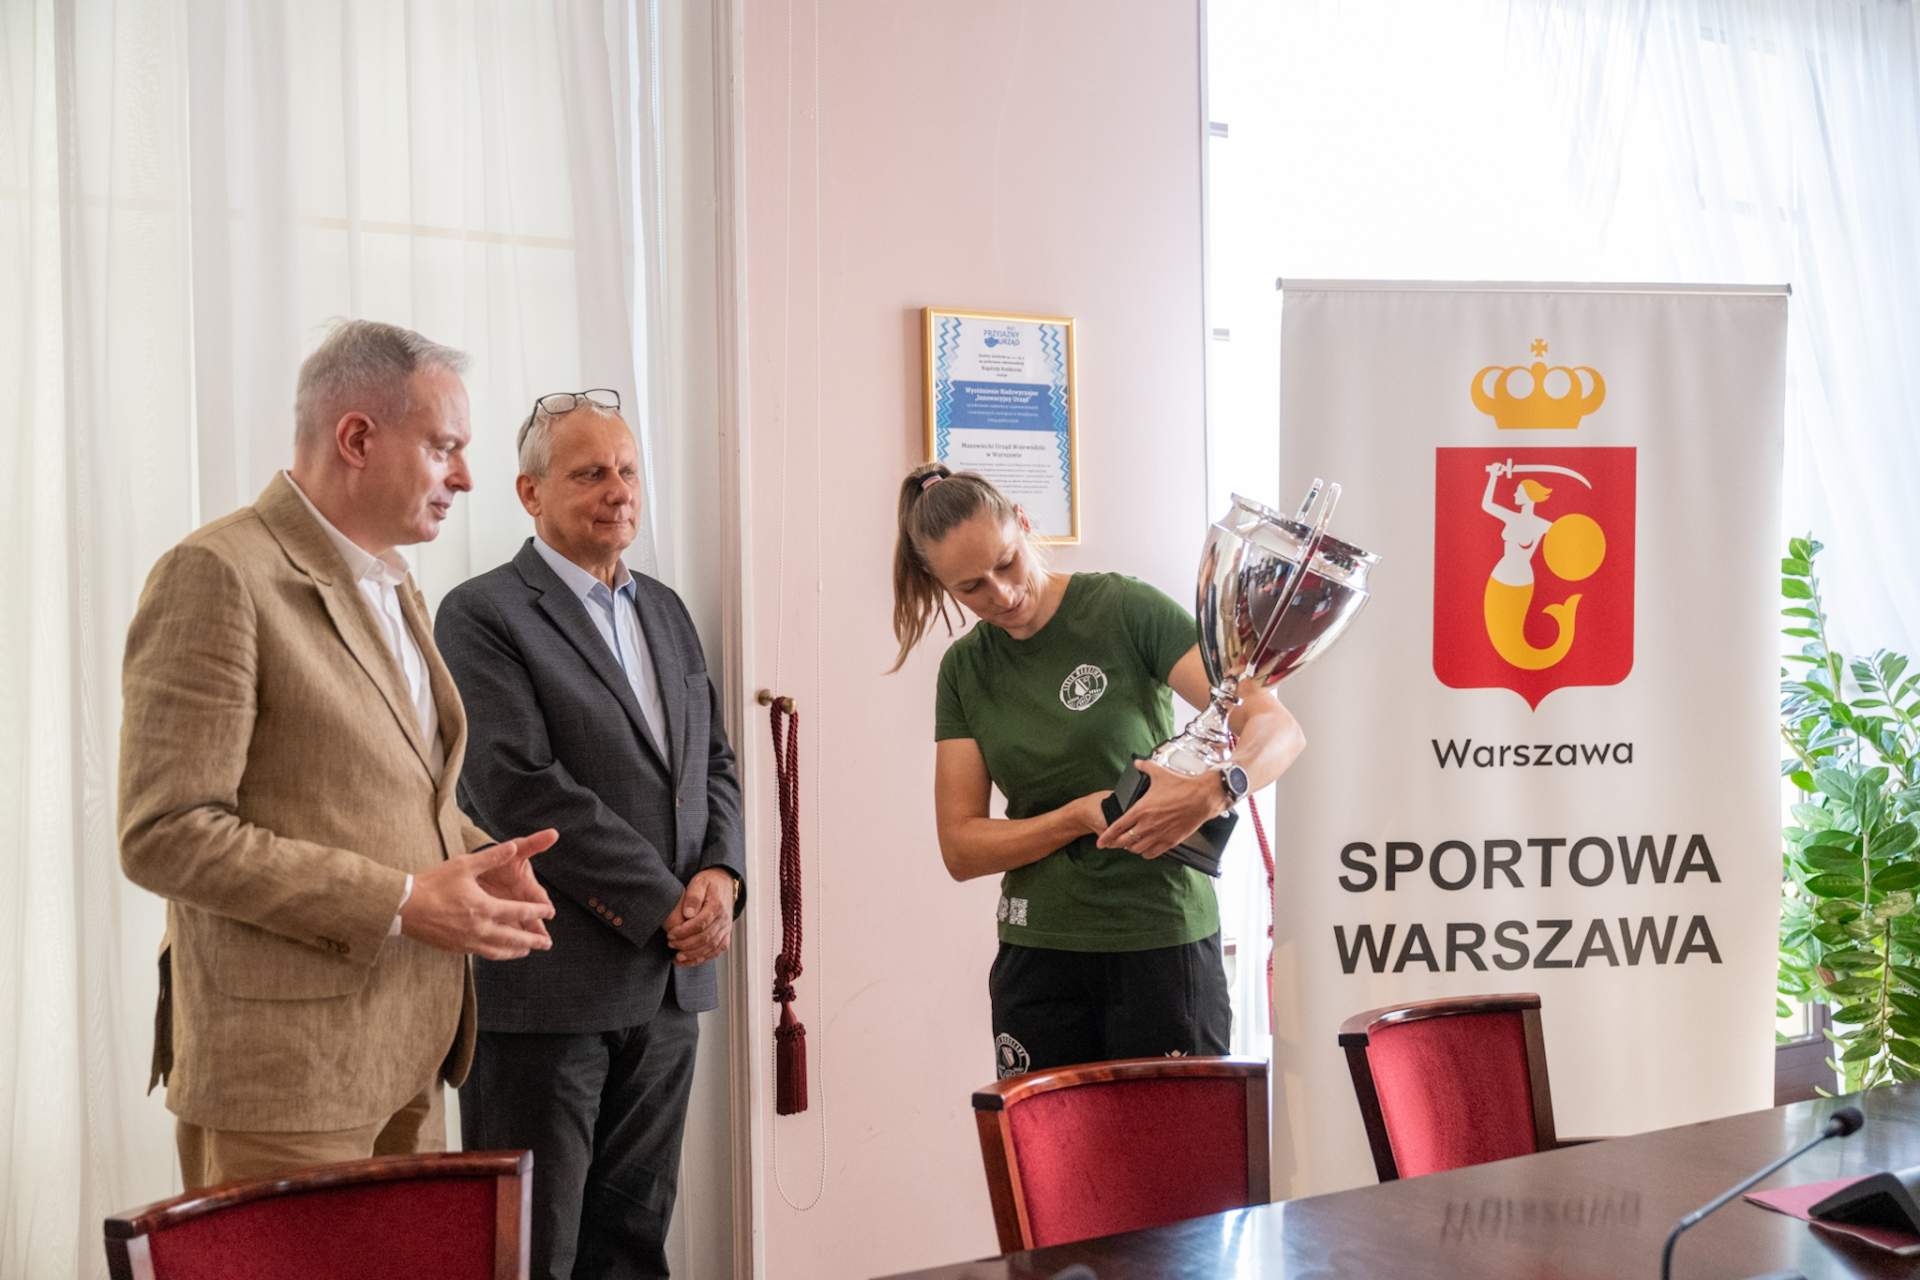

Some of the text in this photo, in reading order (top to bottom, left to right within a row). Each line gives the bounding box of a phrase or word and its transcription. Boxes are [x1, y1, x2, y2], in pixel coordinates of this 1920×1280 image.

[1431, 738, 1634, 769] Warszawa
[1338, 833, 1722, 893] SPORTOWA
[1333, 914, 1723, 975] WARSZAWA
